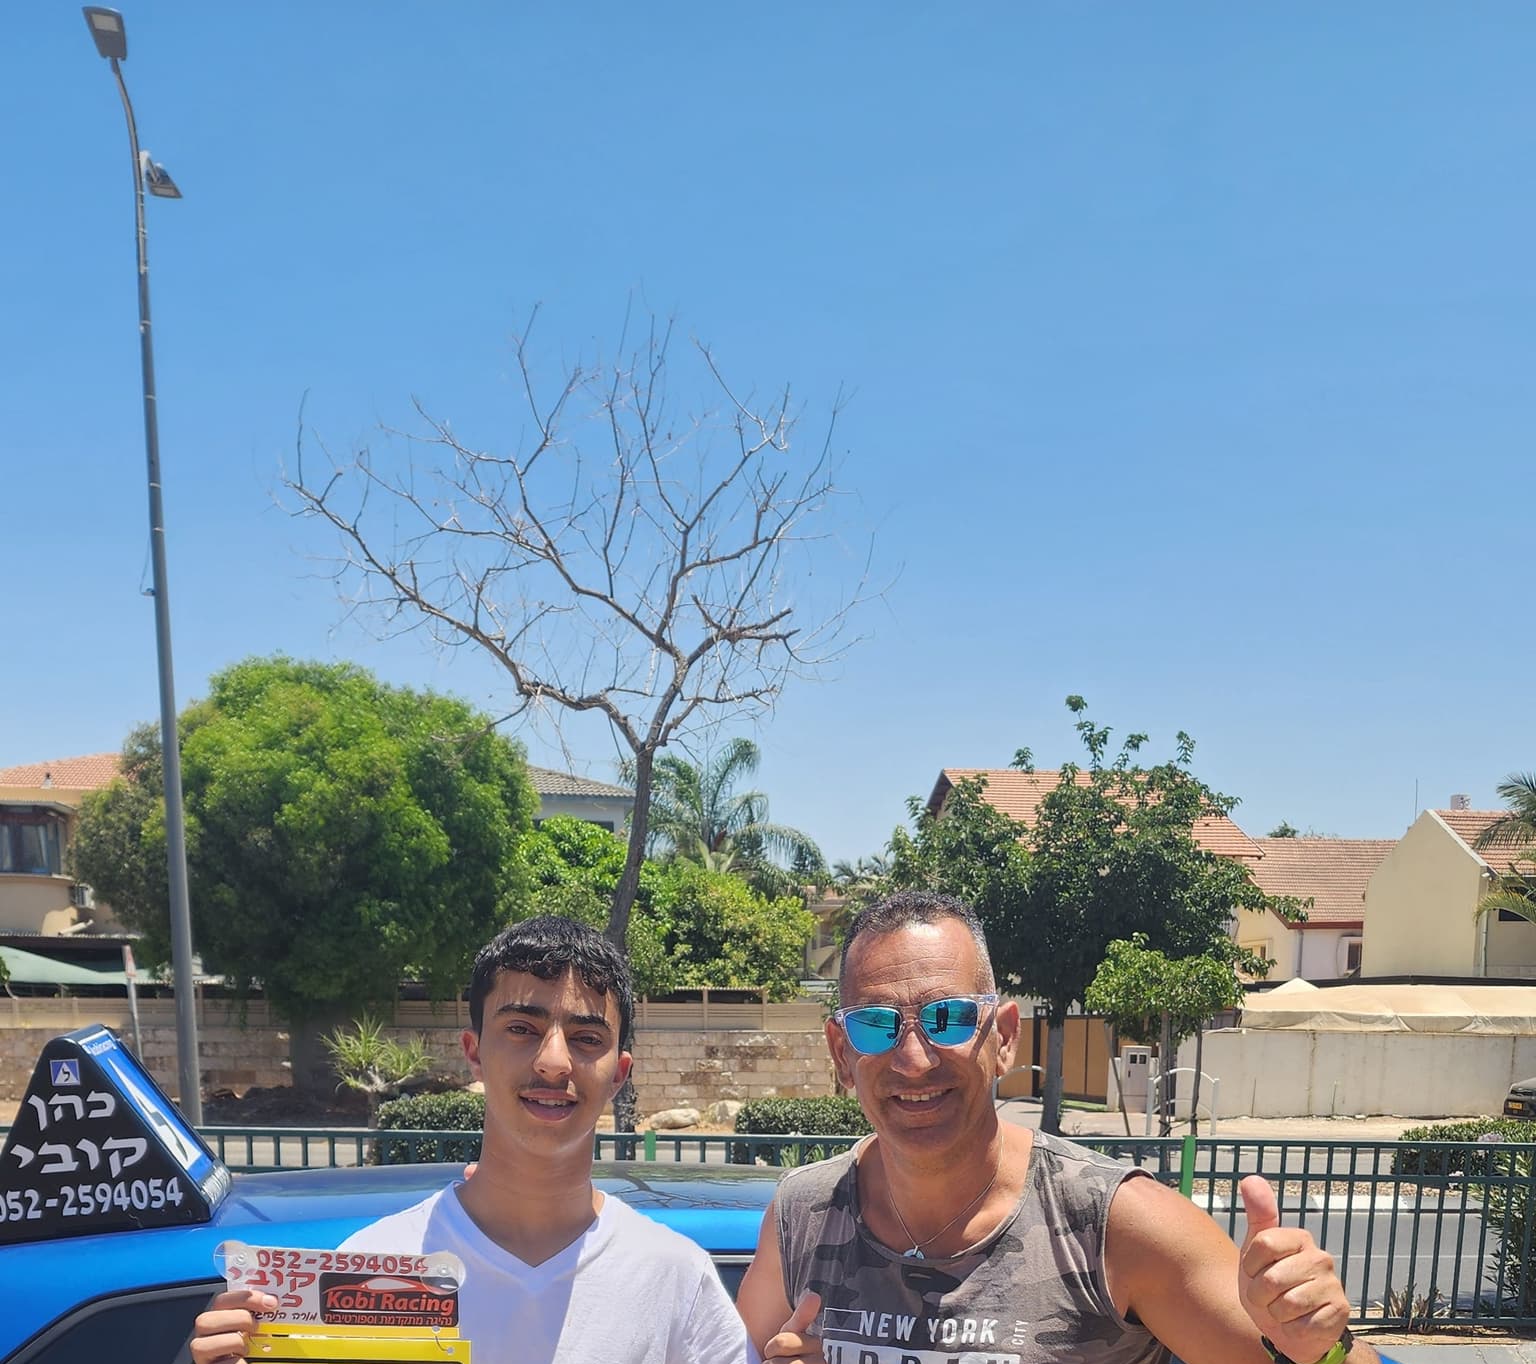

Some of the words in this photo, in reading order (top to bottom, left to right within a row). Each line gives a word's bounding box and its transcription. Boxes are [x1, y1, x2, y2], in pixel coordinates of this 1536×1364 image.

[62, 1068, 71, 1082] ל
[28, 1090, 116, 1131] כהן
[10, 1137, 148, 1179] קובי
[256, 1249, 429, 1274] 052-2594054
[228, 1266, 316, 1293] קובי
[326, 1291, 376, 1309] Kobi
[381, 1294, 455, 1315] Racing
[859, 1311, 917, 1342] NEW
[927, 1318, 999, 1347] YORK
[1011, 1319, 1029, 1346] CITY
